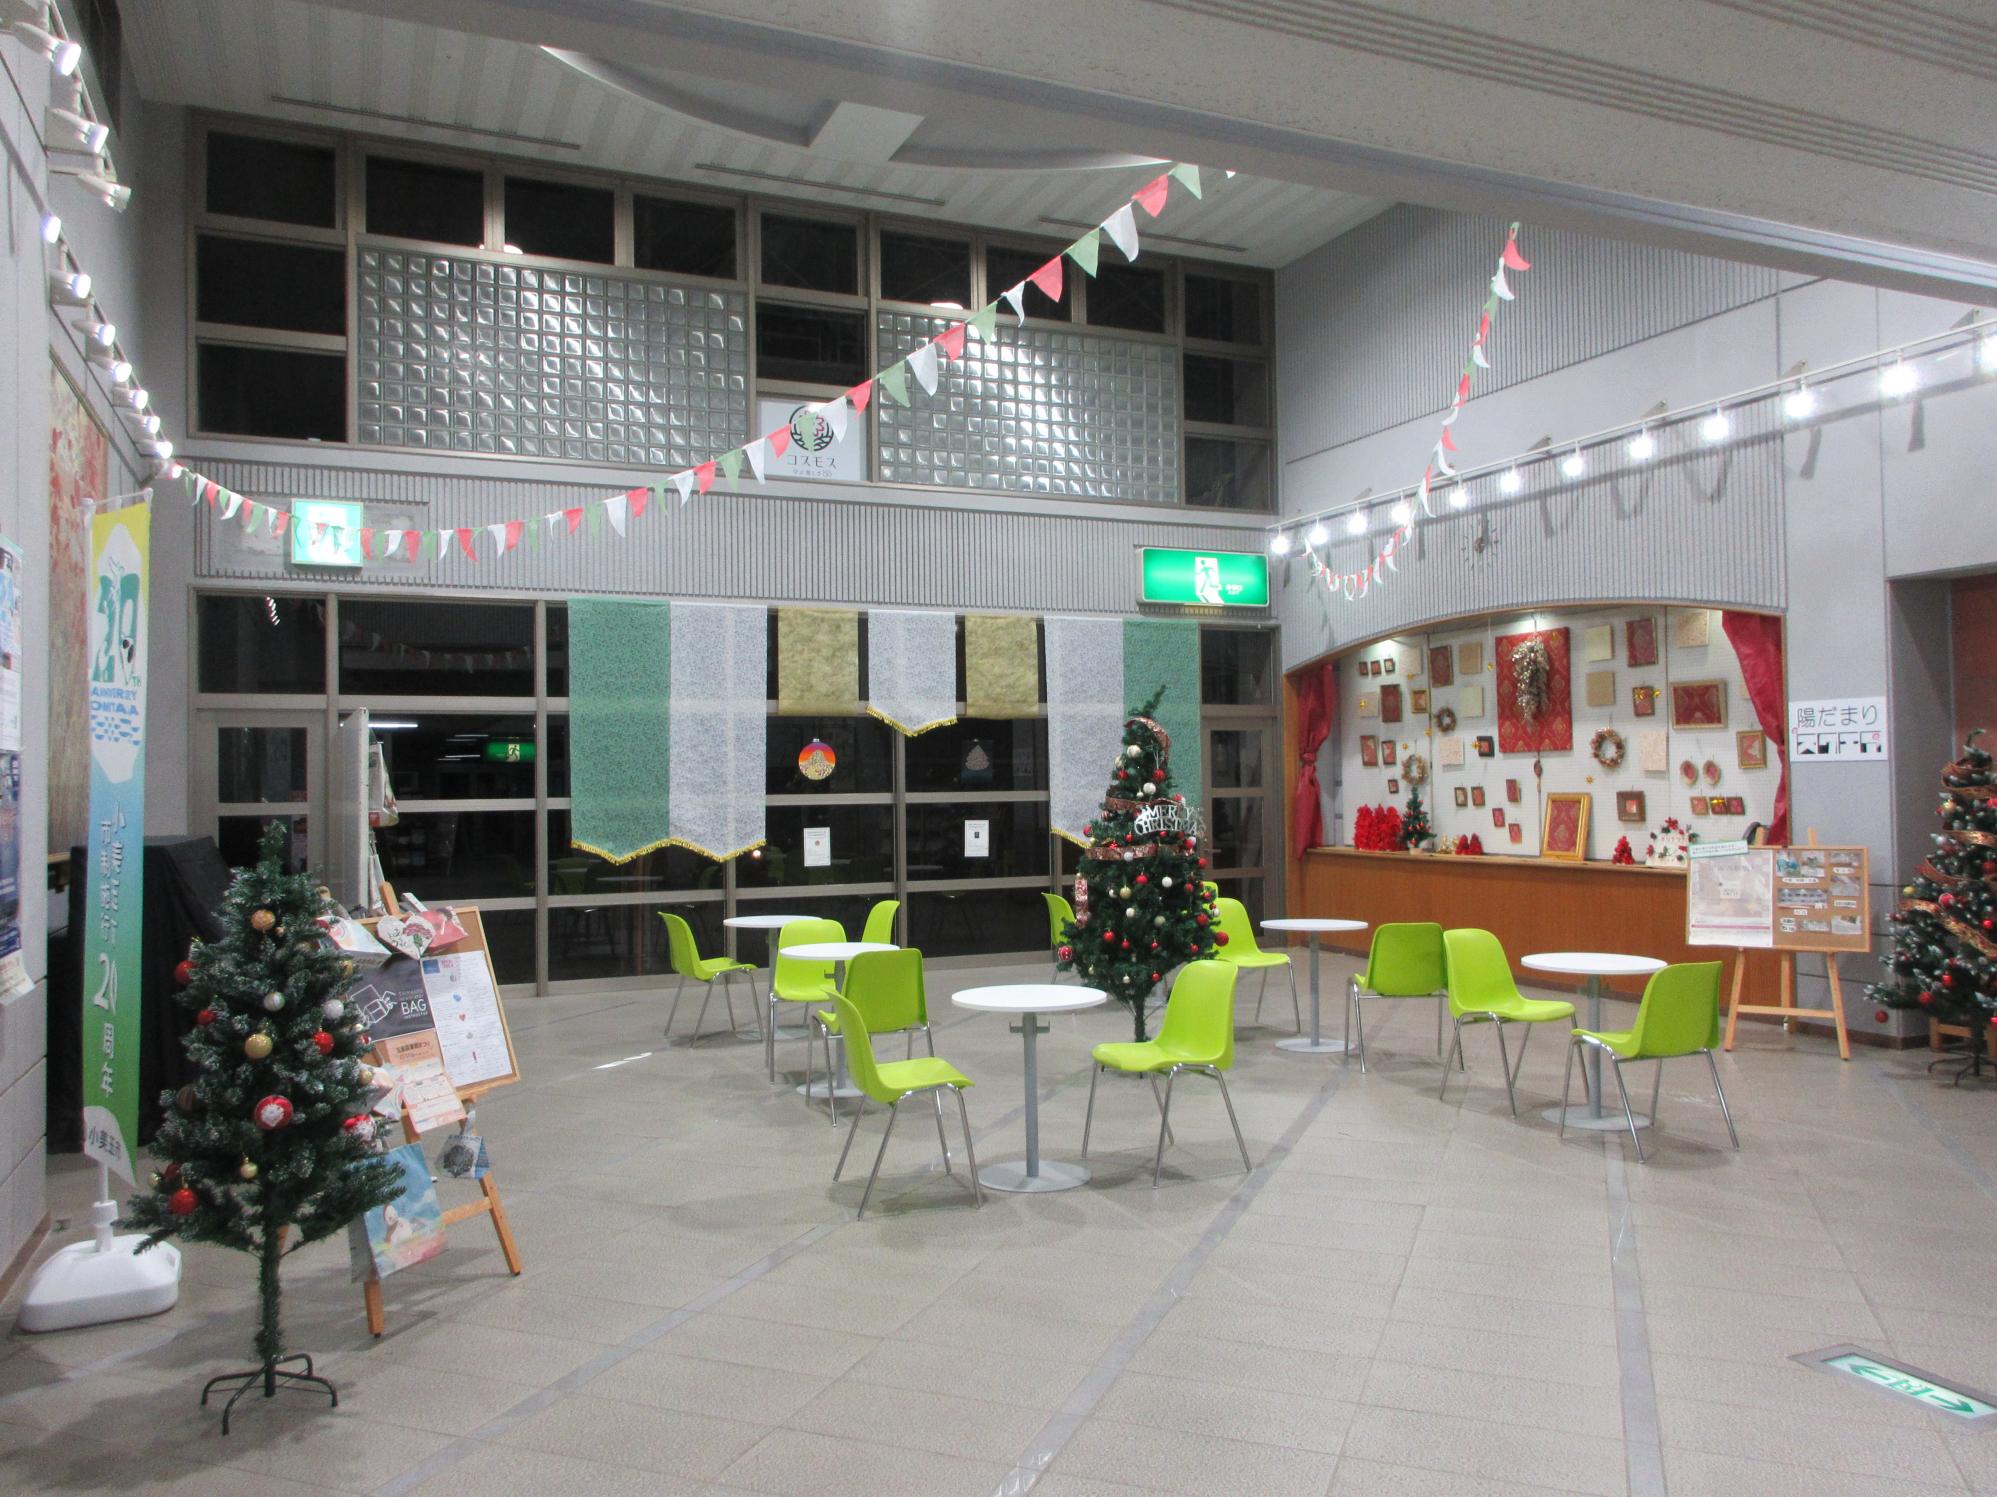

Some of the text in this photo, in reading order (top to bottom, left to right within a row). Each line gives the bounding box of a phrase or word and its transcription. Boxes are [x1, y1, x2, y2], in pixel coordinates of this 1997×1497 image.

[787, 454, 837, 470] コスモス
[1797, 704, 1878, 728] 陽だまり
[401, 999, 427, 1015] BAG
